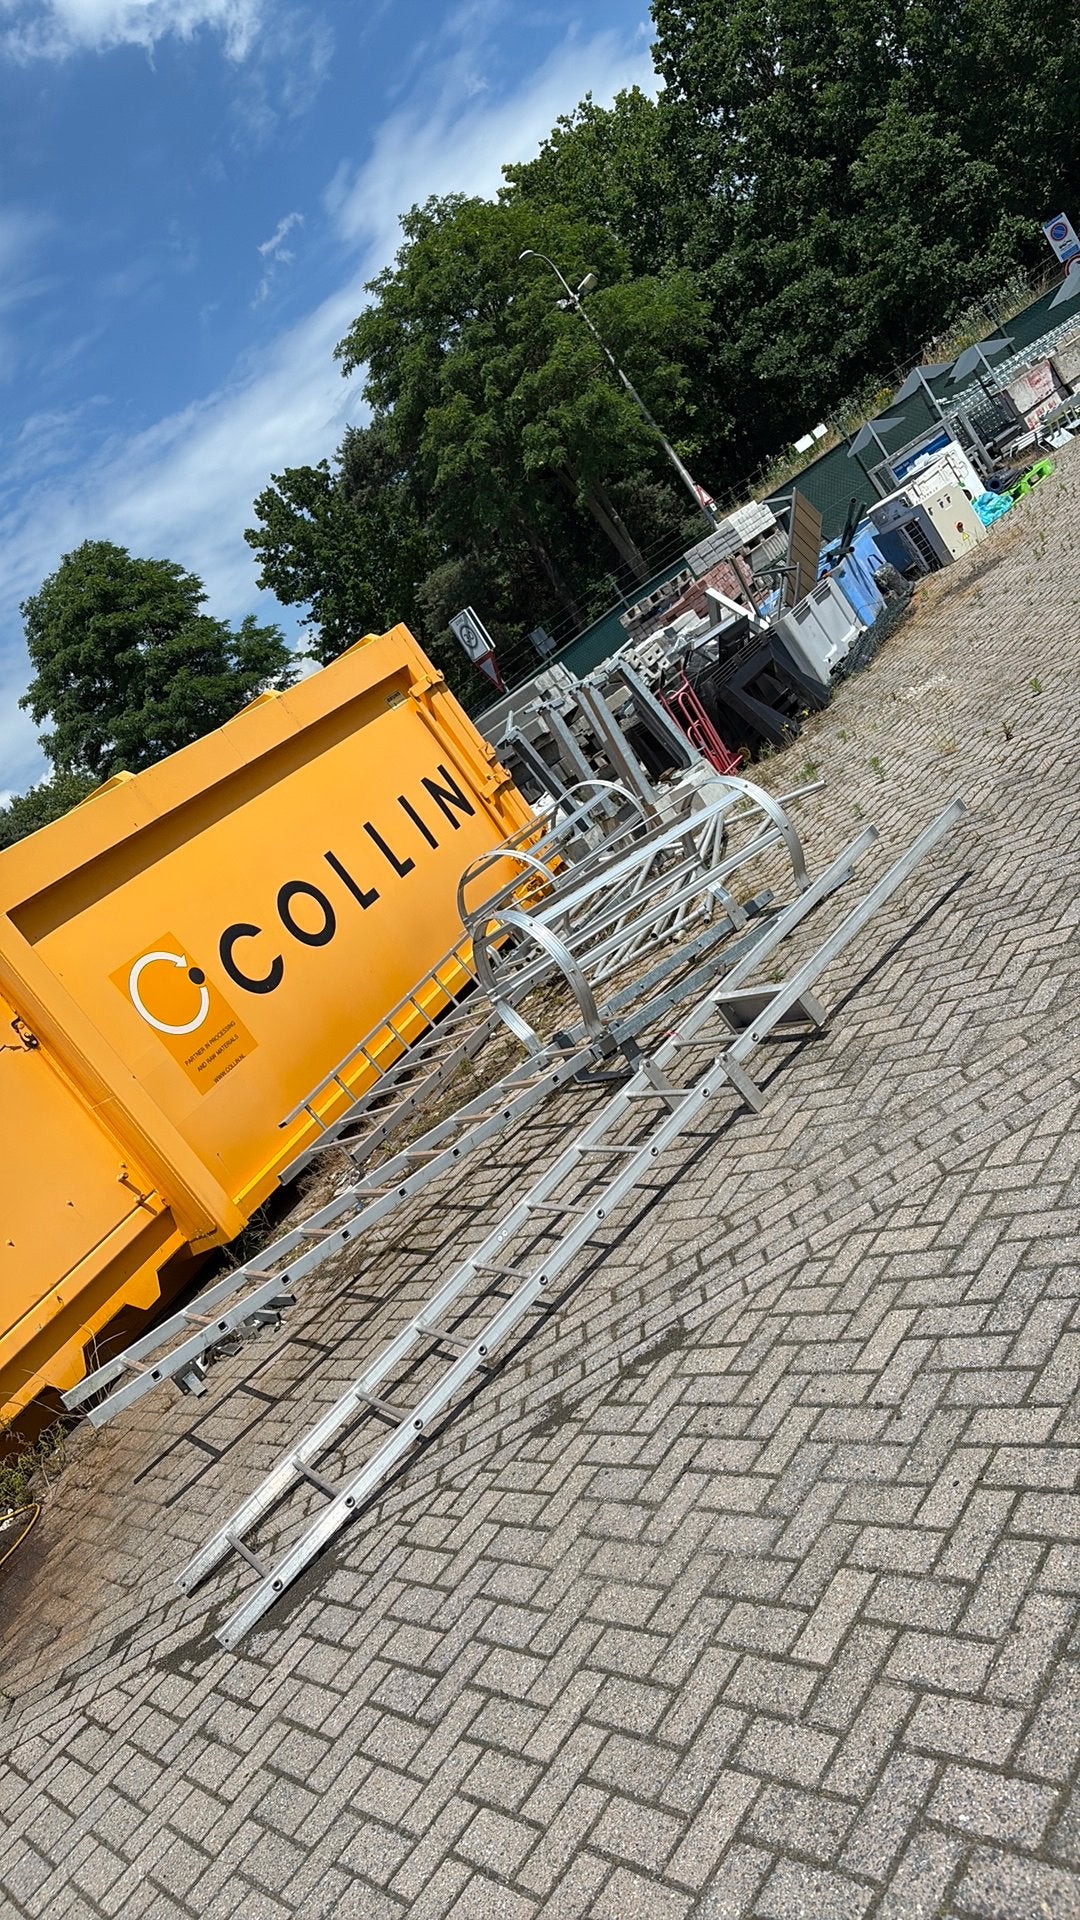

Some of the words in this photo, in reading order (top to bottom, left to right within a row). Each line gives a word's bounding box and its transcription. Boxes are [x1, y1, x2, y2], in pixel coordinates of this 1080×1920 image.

[219, 764, 476, 995] COLLIN
[184, 1046, 206, 1067] PARTNER
[209, 1020, 236, 1045] PROCESSING
[197, 1062, 207, 1072] AND
[206, 1054, 217, 1064] RAW
[216, 1034, 239, 1055] MATERIALS
[213, 1053, 246, 1084] WWW.COLLIN.NL
